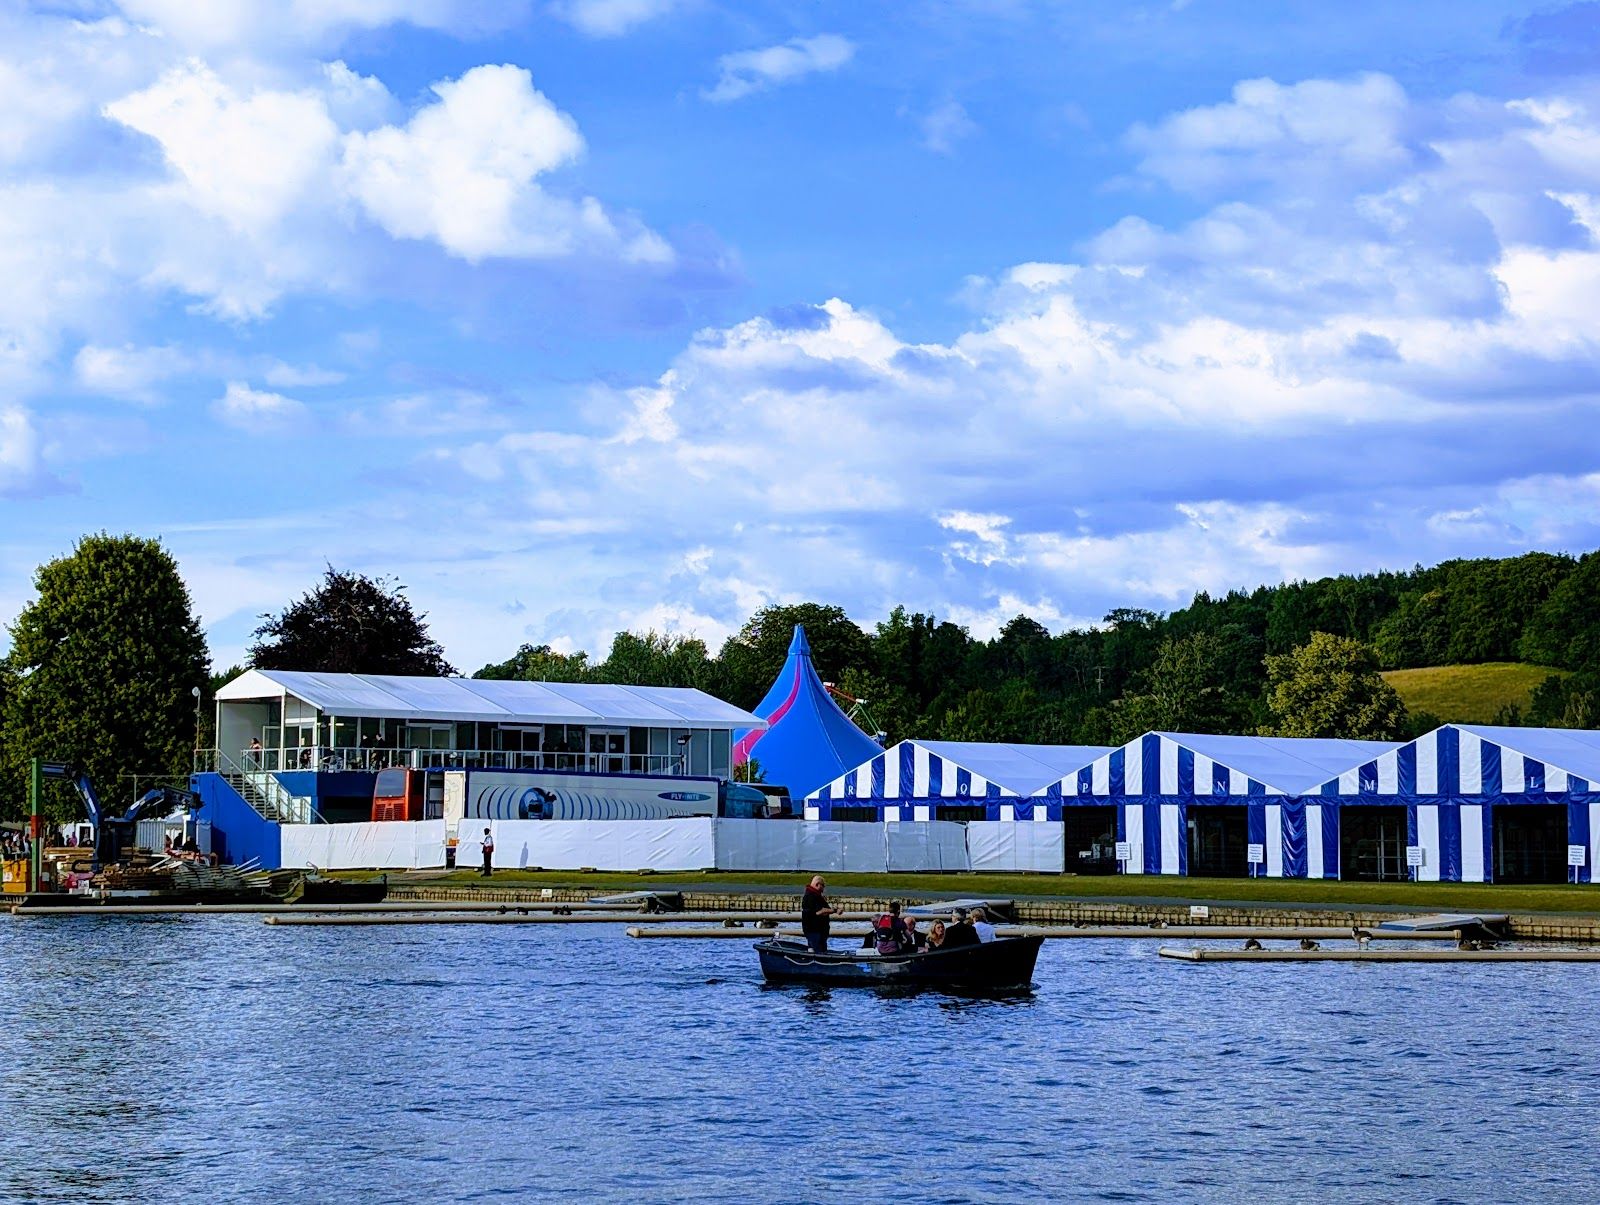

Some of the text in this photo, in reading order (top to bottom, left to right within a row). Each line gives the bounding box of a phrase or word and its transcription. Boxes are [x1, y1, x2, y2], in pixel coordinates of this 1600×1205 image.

[1082, 782, 1090, 793] P
[1217, 780, 1226, 792] N
[1364, 779, 1376, 791] M
[1530, 776, 1539, 788] L
[847, 785, 854, 796] R
[960, 783, 968, 796] Q
